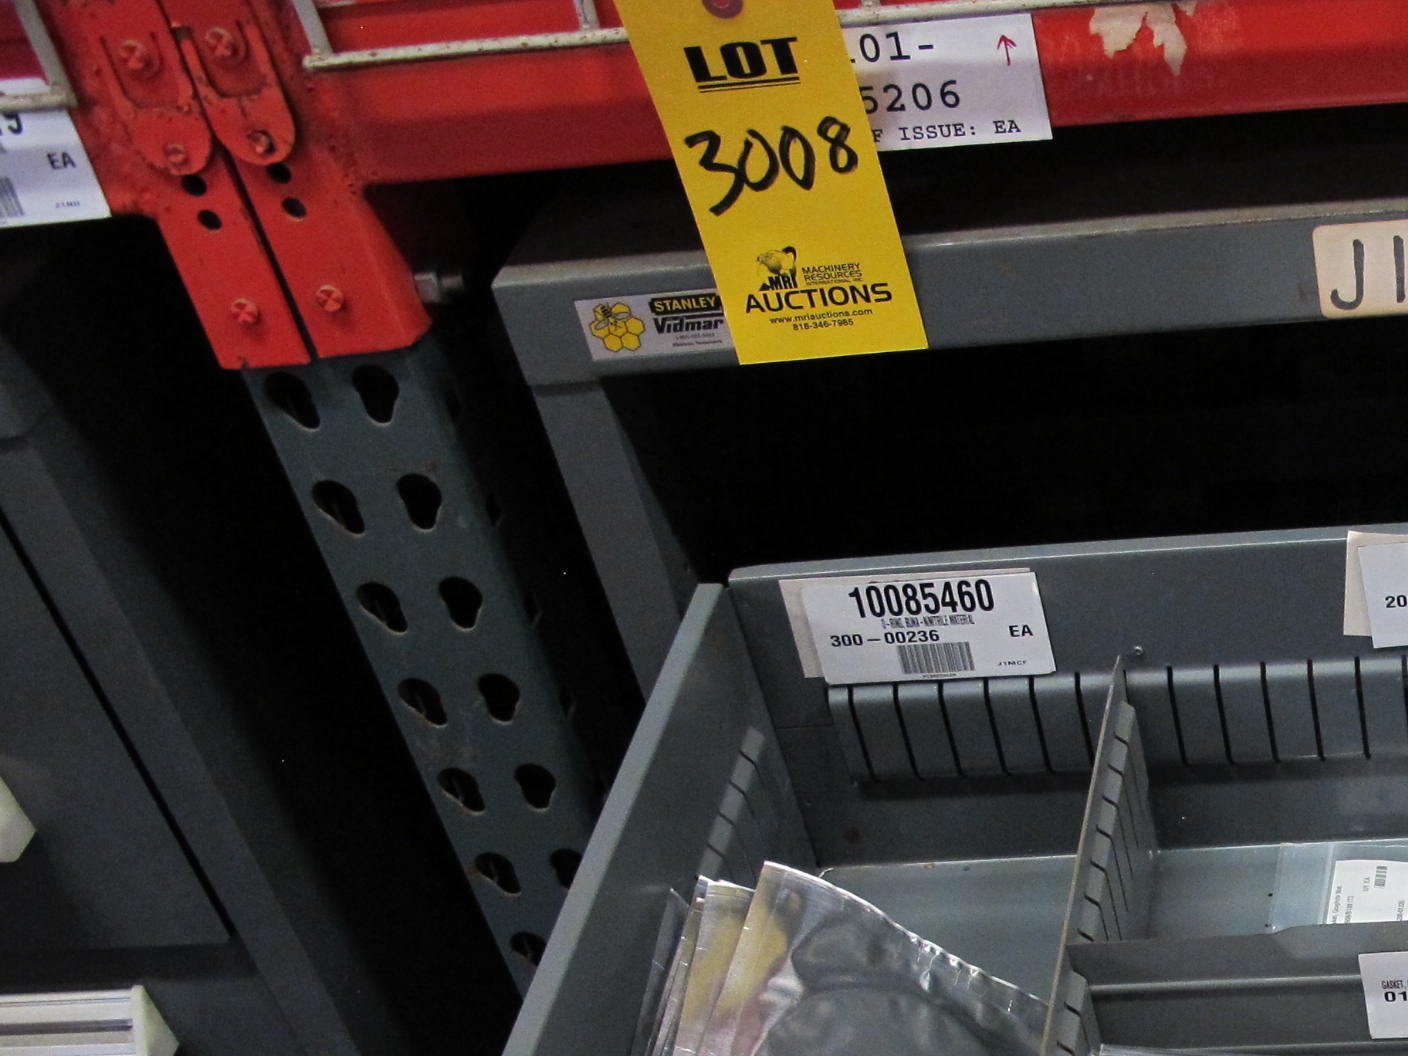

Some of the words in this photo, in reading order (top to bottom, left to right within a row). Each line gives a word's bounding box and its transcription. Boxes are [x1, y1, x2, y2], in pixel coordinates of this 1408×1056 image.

[683, 37, 801, 85] LOT
[899, 123, 978, 142] ISSUE:
[993, 119, 1022, 135] EA
[47, 152, 76, 170] EA
[685, 115, 859, 216] 3008
[802, 261, 861, 274] MACHINERY
[804, 270, 863, 283] RESOURCES
[653, 295, 717, 312] STANLEY
[745, 282, 893, 313] AUCTIONS
[653, 316, 724, 334] Vidmar
[849, 579, 995, 618] 10085460
[1009, 624, 1033, 637] EA
